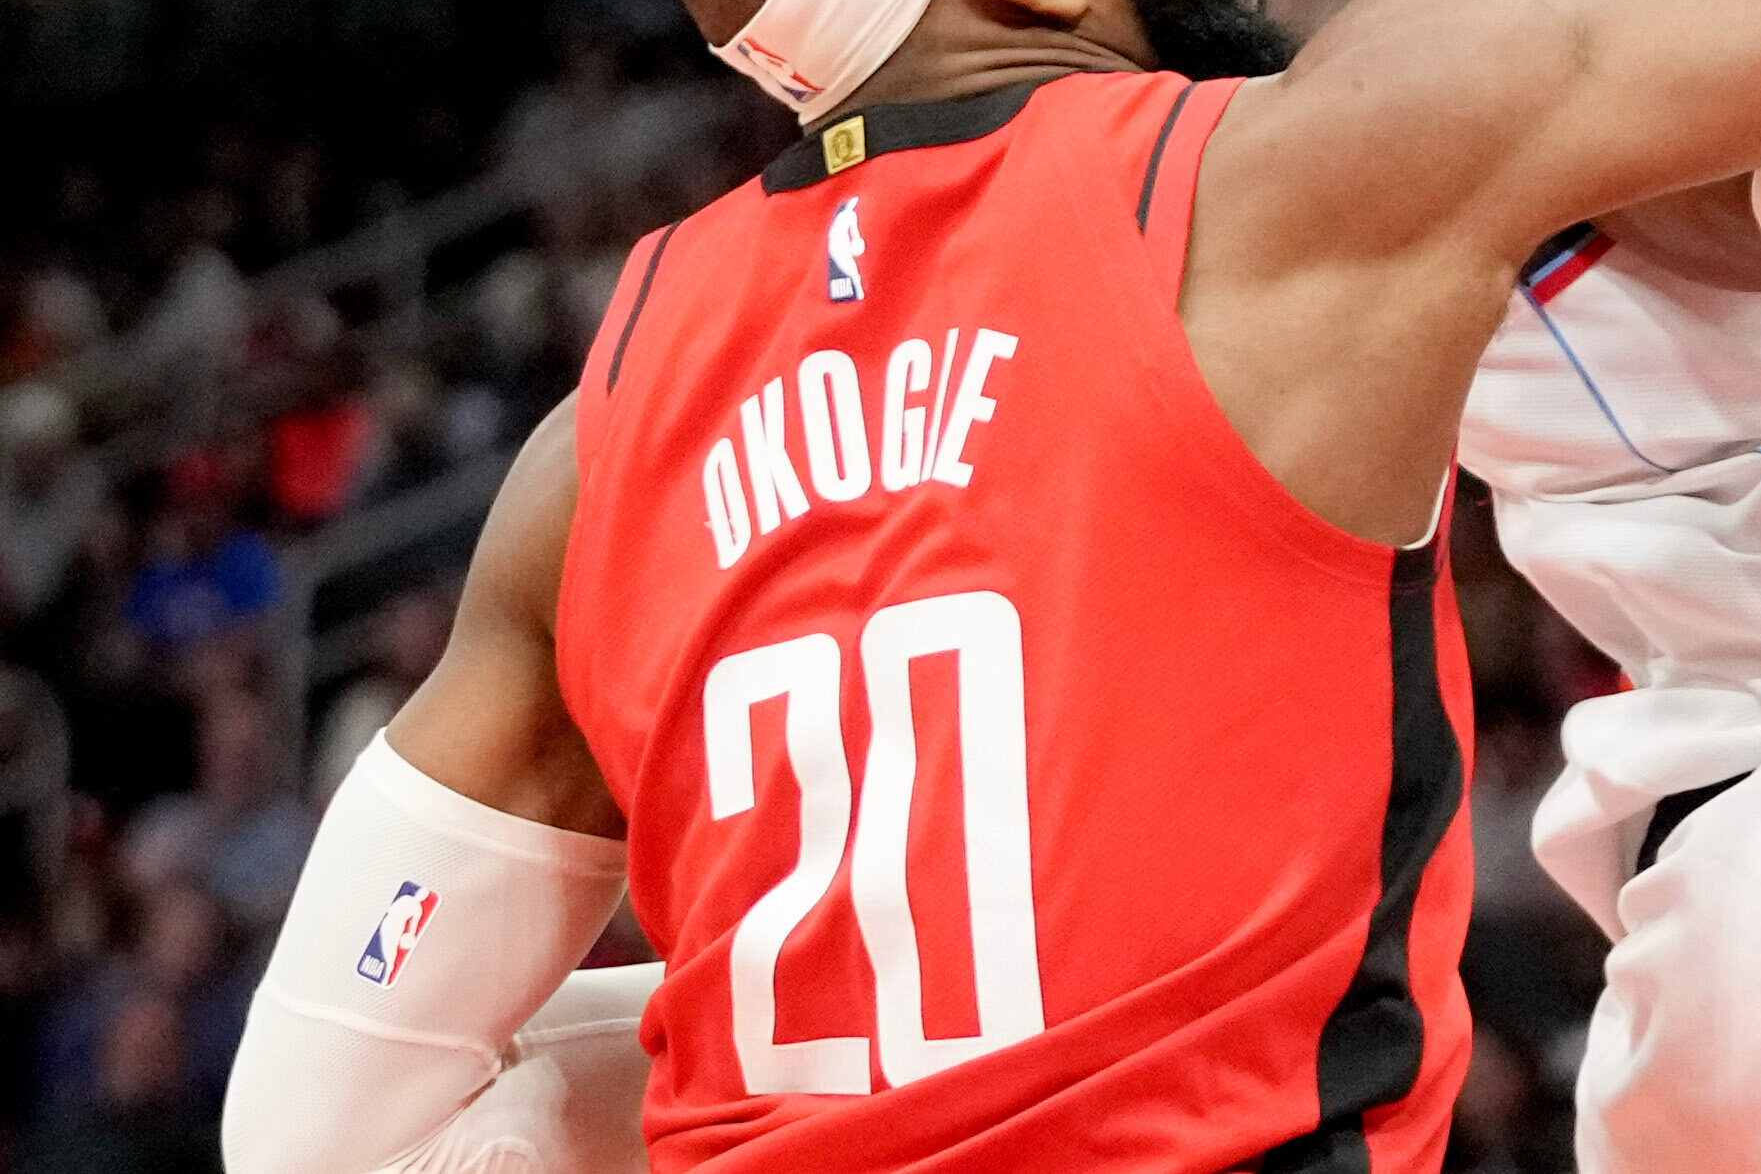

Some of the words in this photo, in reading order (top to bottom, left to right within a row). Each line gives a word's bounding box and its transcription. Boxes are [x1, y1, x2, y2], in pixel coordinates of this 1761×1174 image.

[702, 327, 1018, 570] OKOGIE
[703, 590, 1044, 1096] 20
[360, 954, 386, 979] NBA
